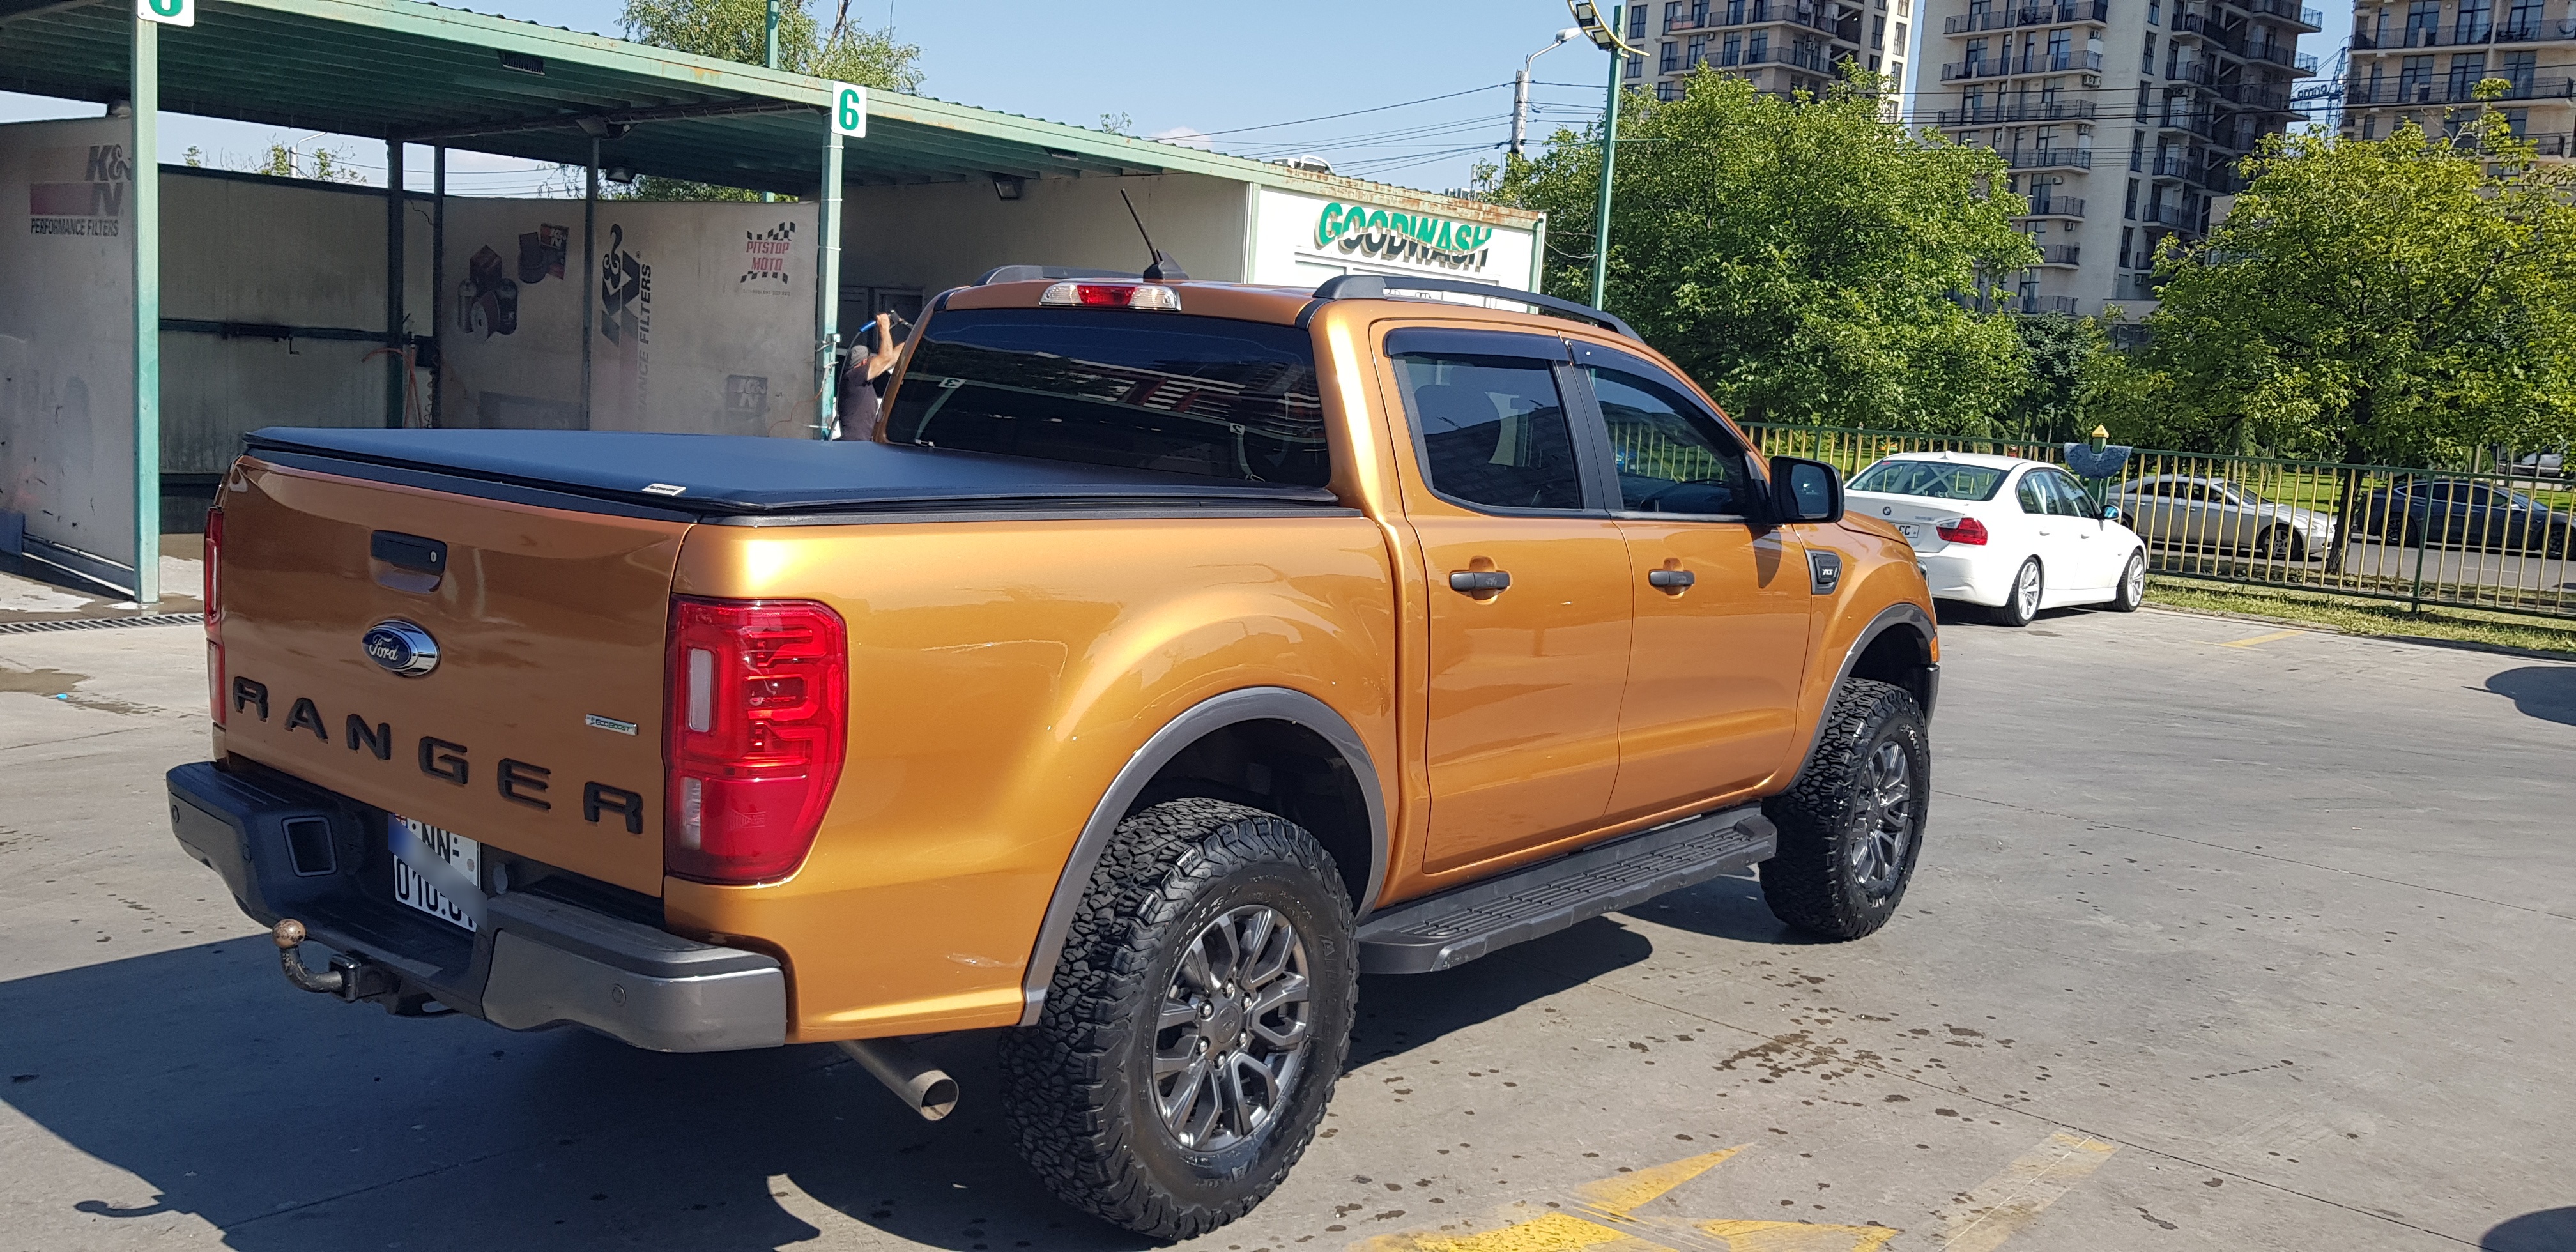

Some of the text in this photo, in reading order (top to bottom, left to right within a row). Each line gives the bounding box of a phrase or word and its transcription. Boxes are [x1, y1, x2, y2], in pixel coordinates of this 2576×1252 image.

[839, 89, 859, 130] 6
[31, 218, 119, 237] PERFORMANCE FILTERS
[1315, 202, 1492, 271] GOODWASH
[746, 241, 790, 254] PITSTOP
[751, 257, 783, 271] MOTO
[640, 264, 651, 345] FILTERS
[369, 634, 400, 661] Ford
[233, 676, 643, 834] RANGER
